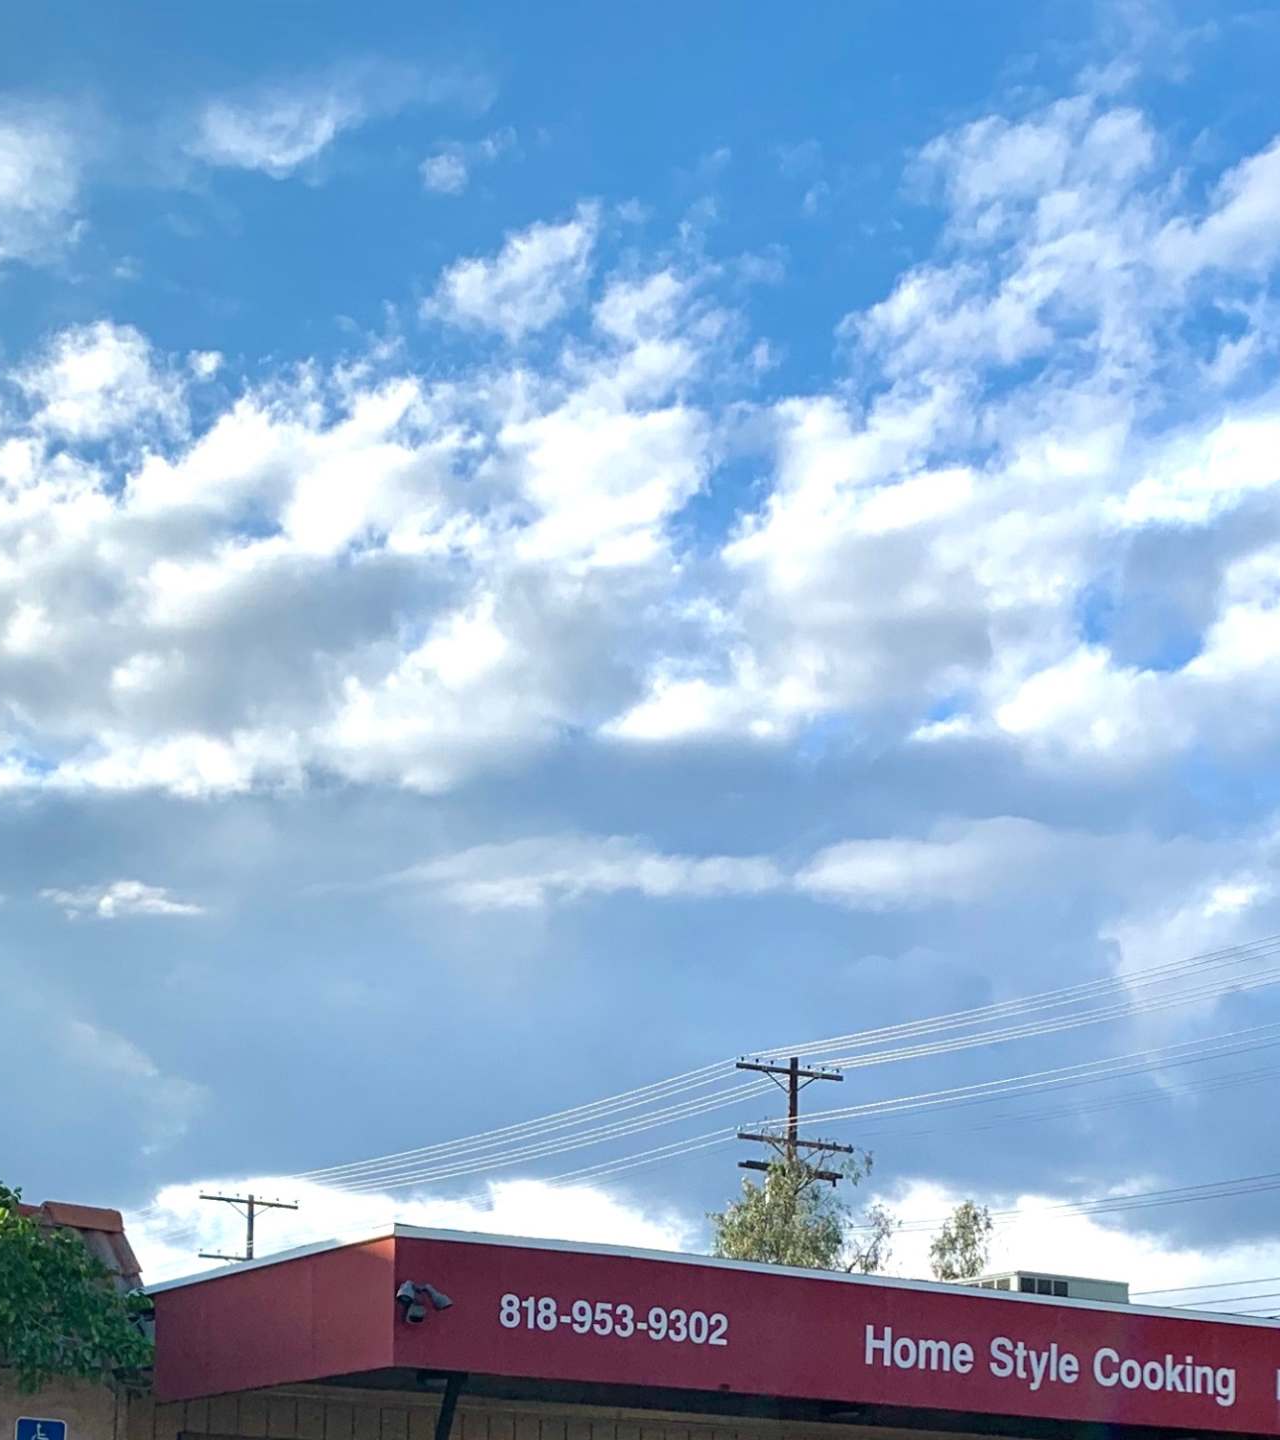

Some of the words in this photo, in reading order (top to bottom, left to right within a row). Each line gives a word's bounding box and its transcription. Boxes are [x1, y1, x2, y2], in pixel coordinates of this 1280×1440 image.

[499, 1294, 729, 1346] 818-953-9302
[865, 1325, 975, 1376] Home
[989, 1336, 1080, 1385] Style
[1093, 1347, 1236, 1407] Cooking
